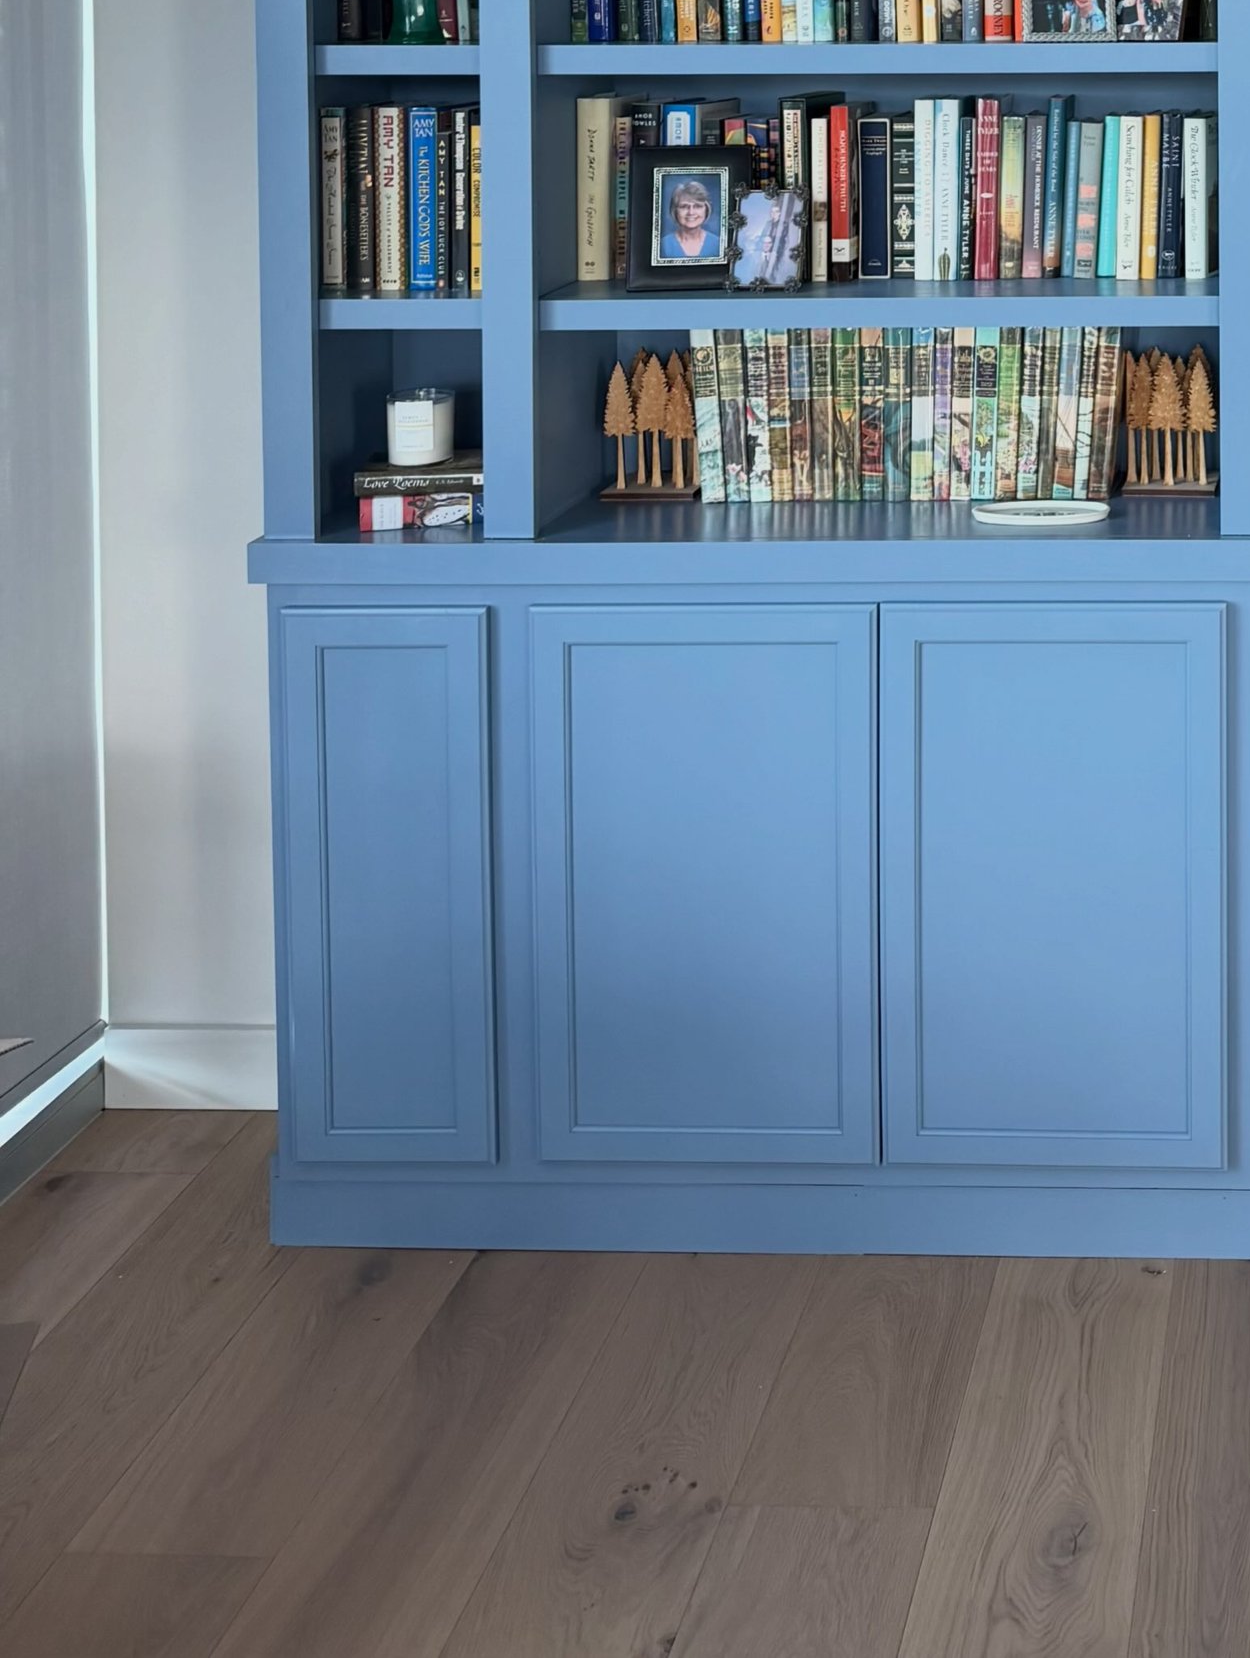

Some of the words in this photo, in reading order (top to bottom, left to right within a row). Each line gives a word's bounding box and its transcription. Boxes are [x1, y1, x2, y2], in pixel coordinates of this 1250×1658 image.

[383, 115, 394, 151] AMY
[383, 154, 394, 188] TAN
[418, 158, 430, 205] KITCHEN
[419, 239, 430, 266] WIFE
[363, 477, 389, 488] Love
[393, 477, 429, 490] Poems
